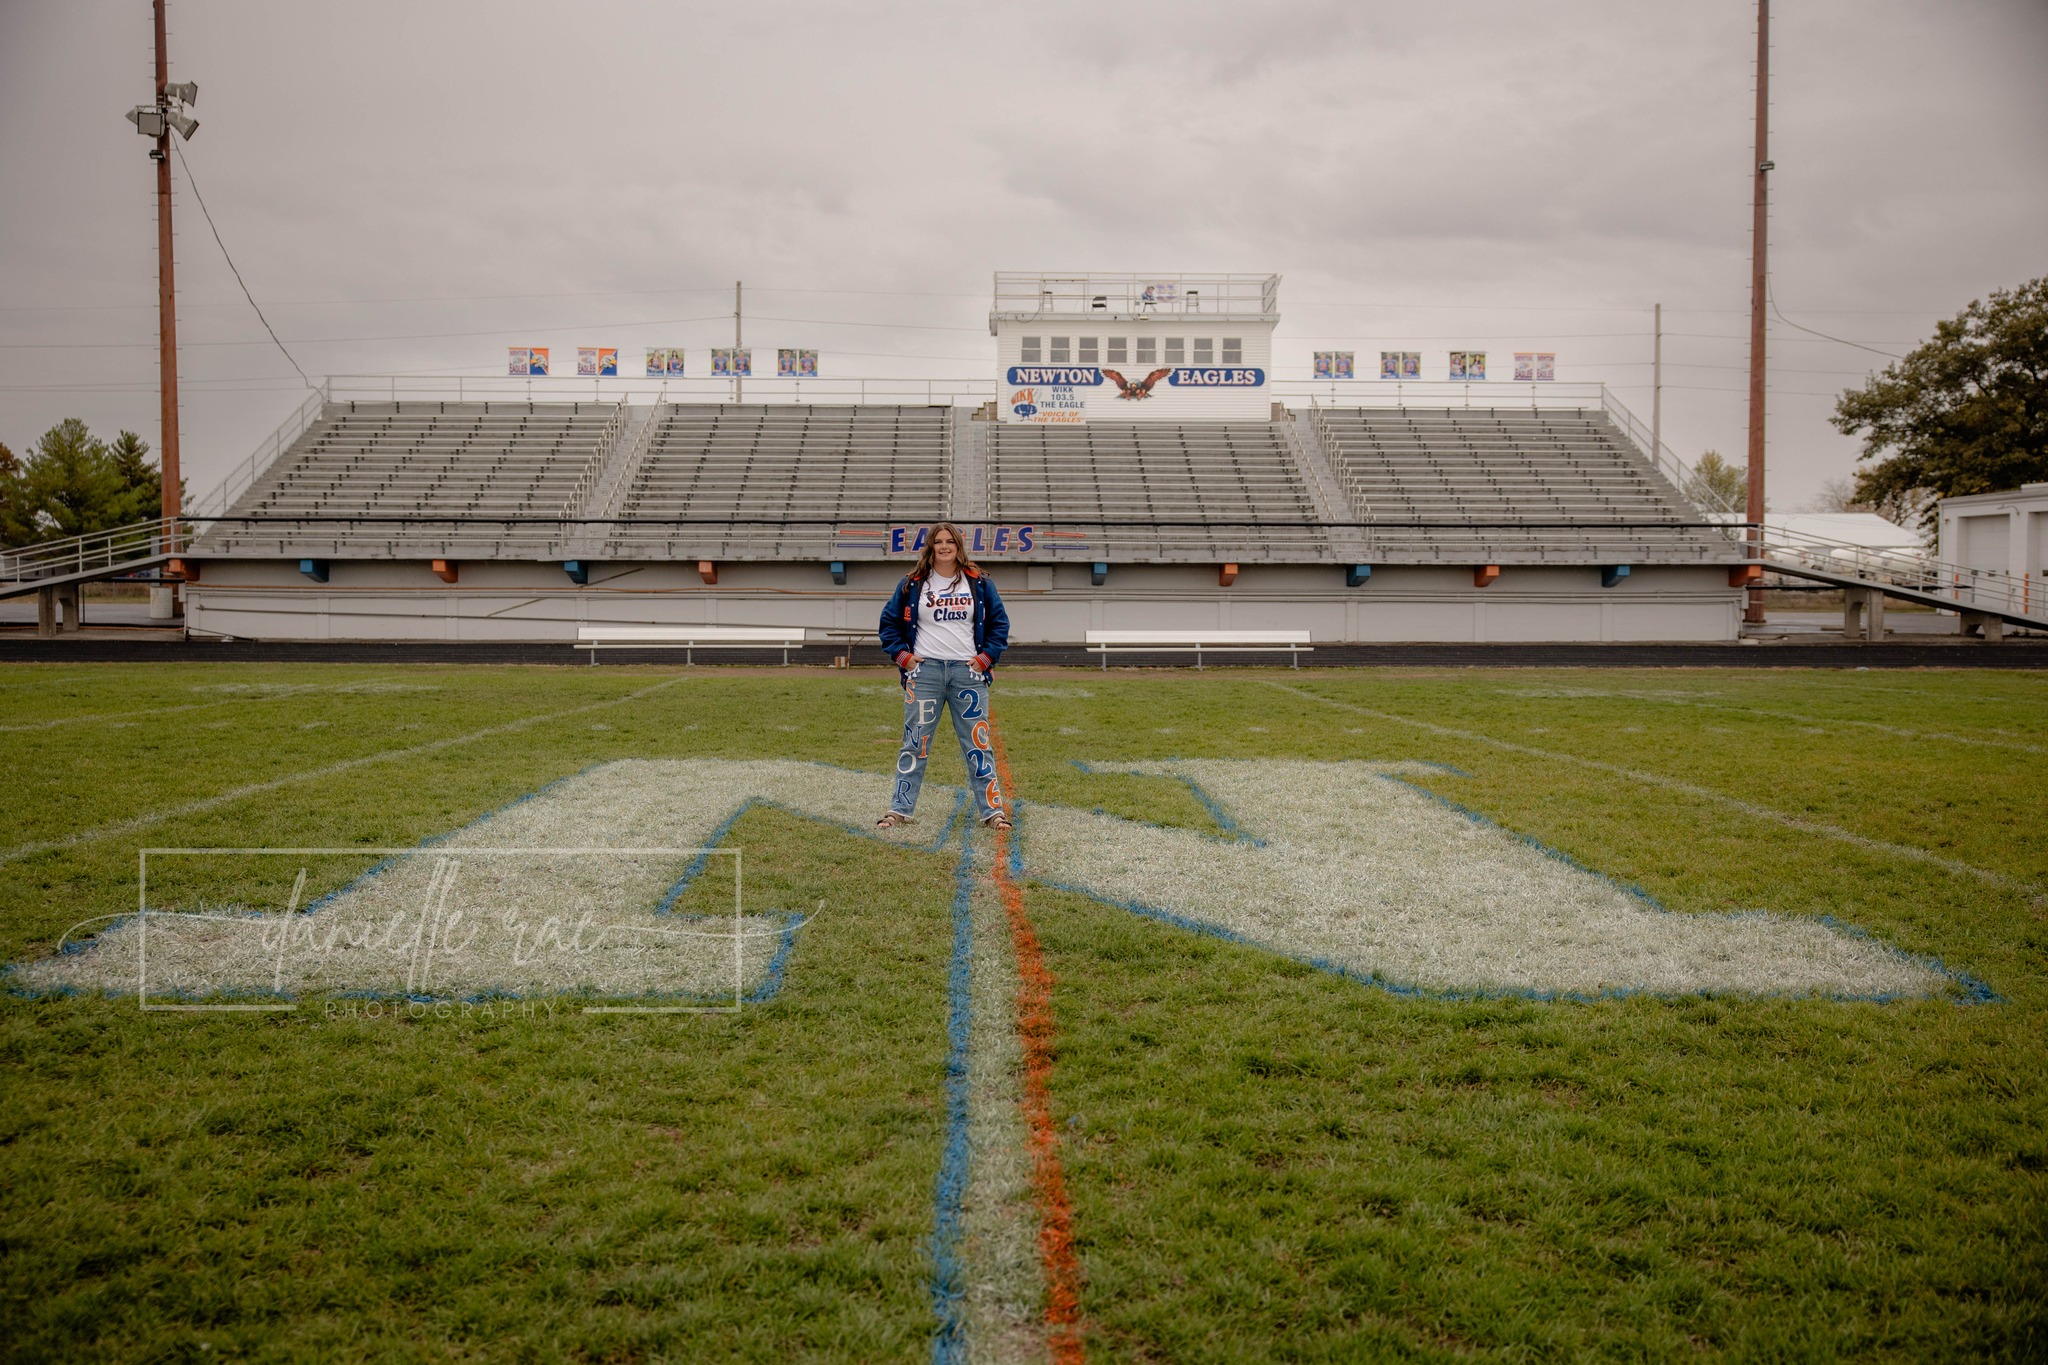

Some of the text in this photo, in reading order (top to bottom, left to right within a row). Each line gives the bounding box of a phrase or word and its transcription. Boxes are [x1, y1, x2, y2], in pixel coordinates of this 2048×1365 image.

[1015, 367, 1096, 384] NEWTON
[1177, 369, 1257, 385] EAGLES
[1010, 387, 1035, 406] WIKK
[889, 525, 1036, 555] EALES
[926, 594, 973, 608] Senior
[933, 608, 968, 622] Class
[957, 688, 1003, 810] 2026
